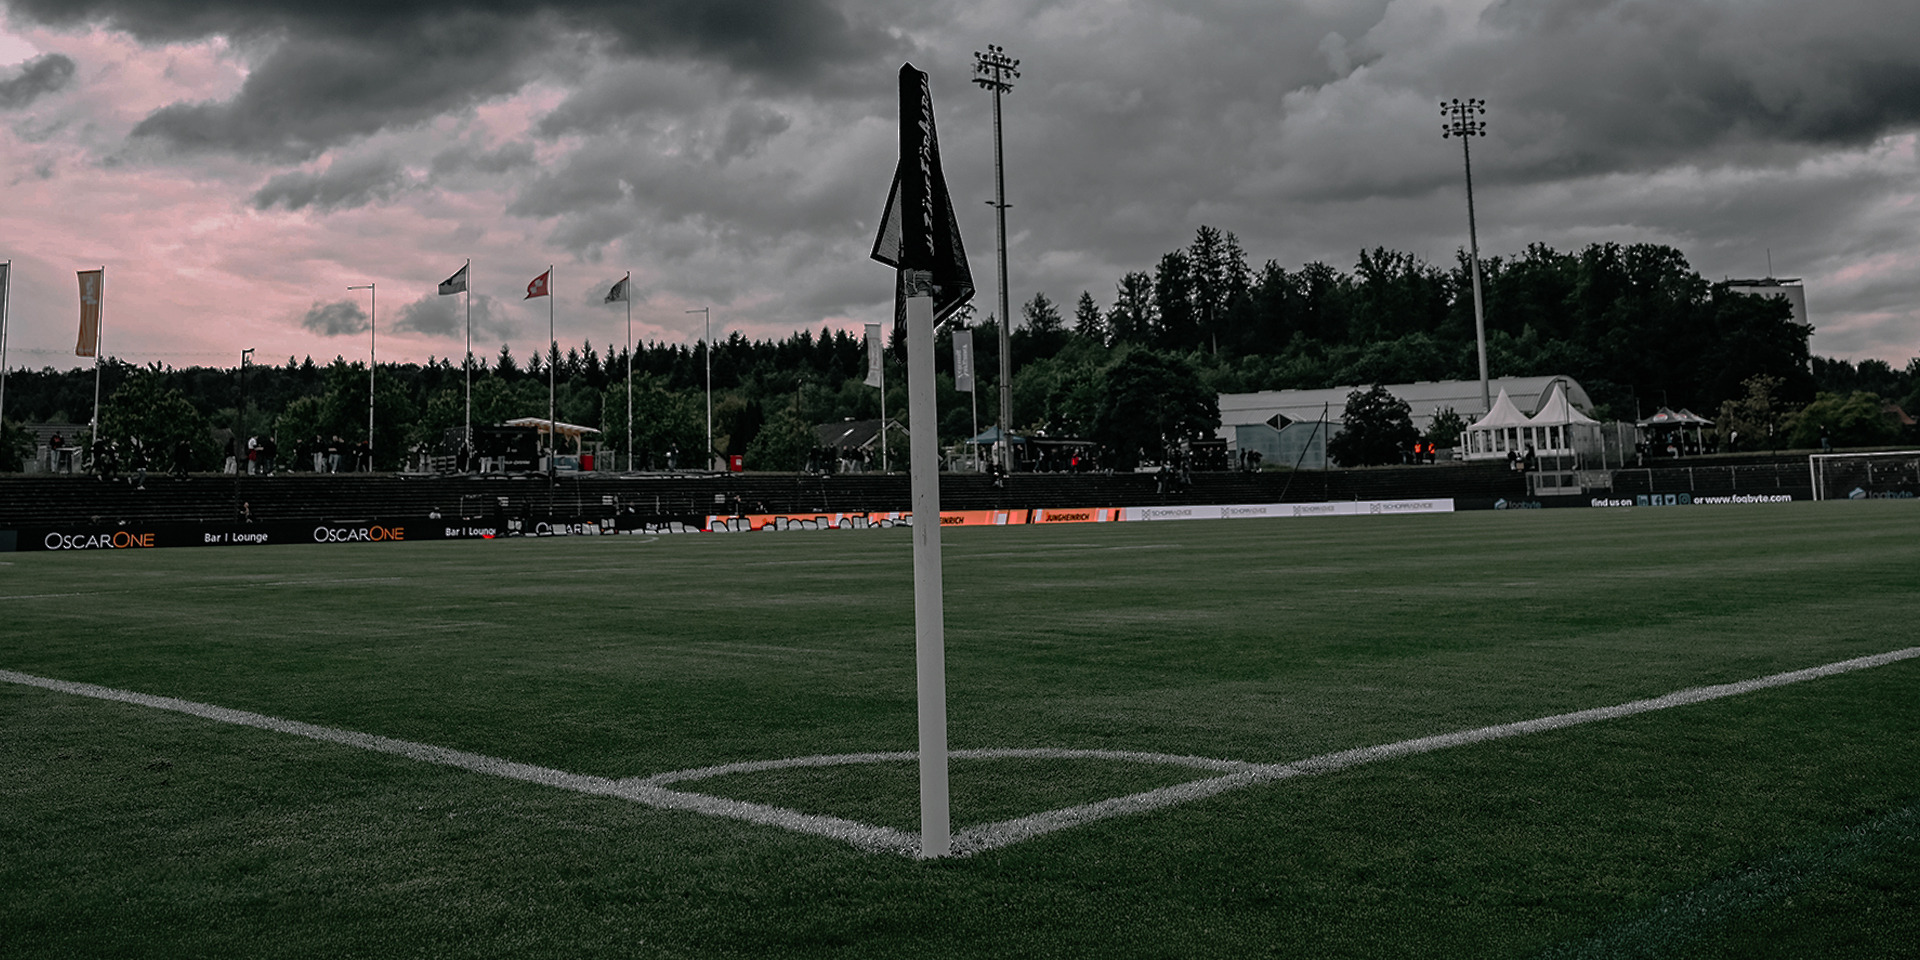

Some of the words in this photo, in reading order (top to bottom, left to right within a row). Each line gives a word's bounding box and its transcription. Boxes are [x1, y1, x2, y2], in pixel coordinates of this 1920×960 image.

[1591, 497, 1609, 507] find
[1609, 499, 1620, 507] us
[1693, 496, 1704, 504] or
[939, 516, 964, 525] EINRICH
[1045, 512, 1090, 522] JUNGHEINRICH
[445, 527, 460, 537] Bar
[204, 532, 221, 543] Bar
[231, 532, 269, 544] Lounge
